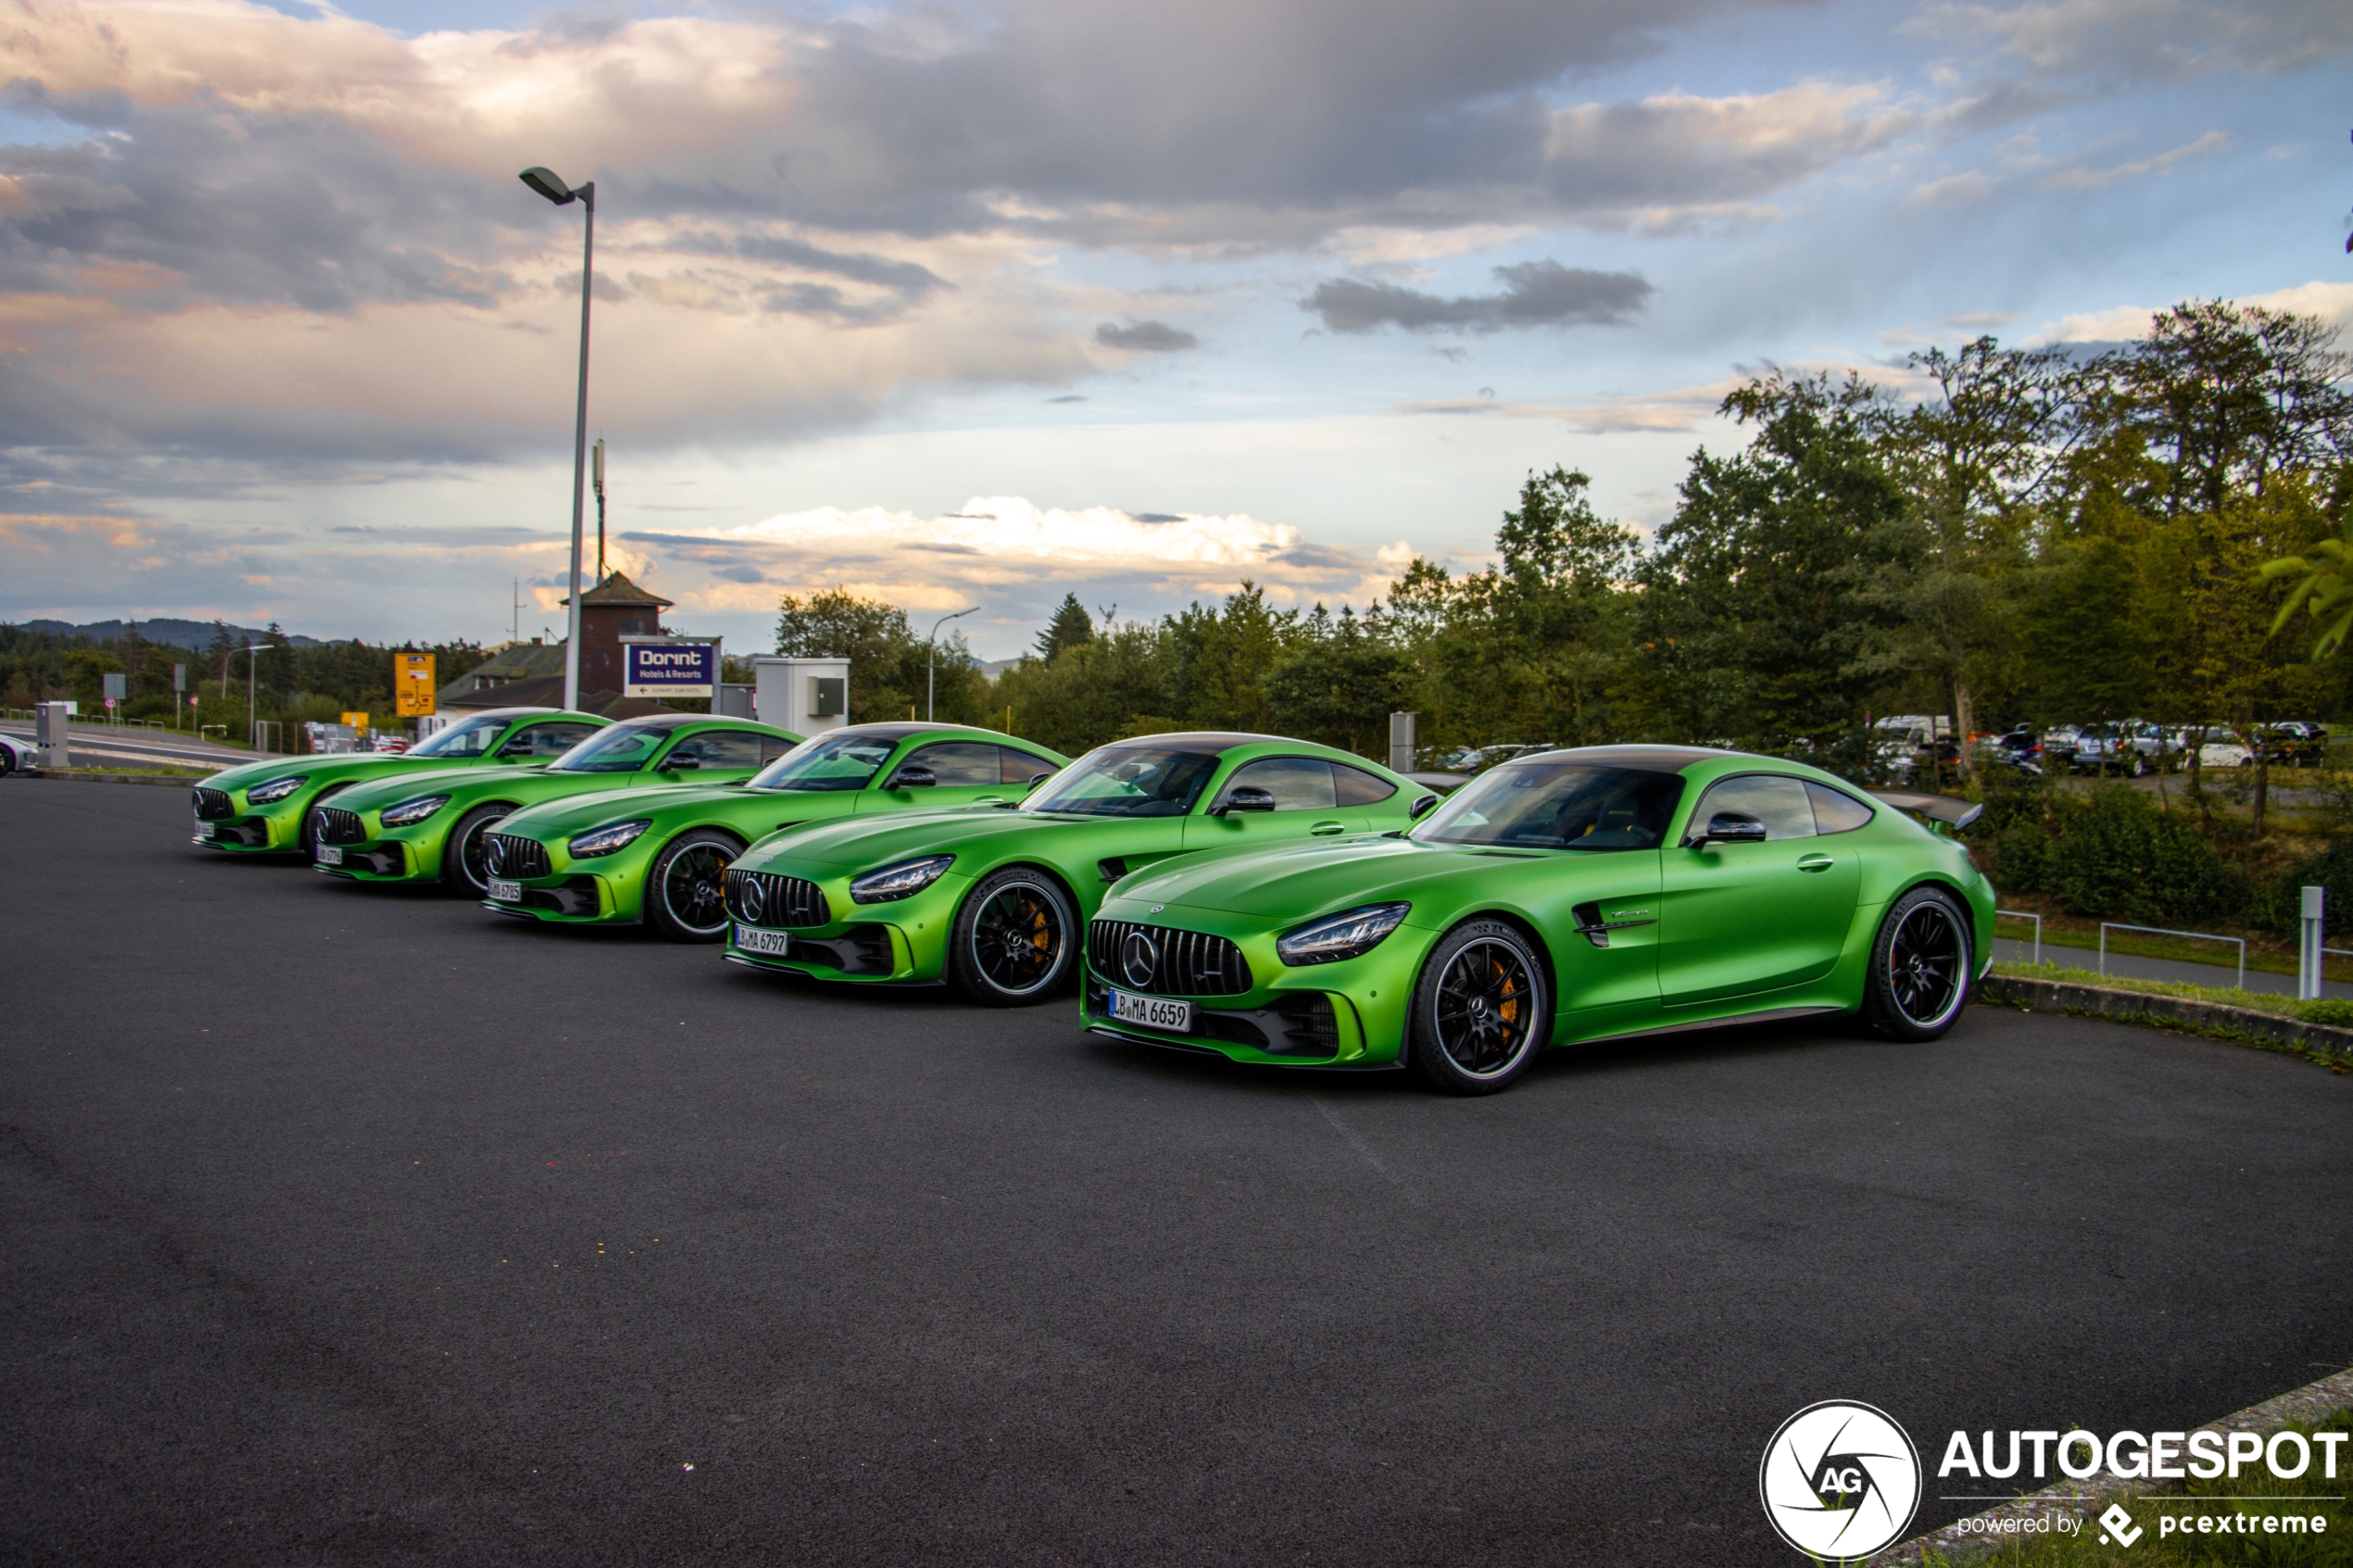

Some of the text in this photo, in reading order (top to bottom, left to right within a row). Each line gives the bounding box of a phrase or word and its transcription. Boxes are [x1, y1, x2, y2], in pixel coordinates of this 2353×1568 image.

[639, 650, 702, 666] Dorint
[639, 669, 702, 680] Hotels & Resorts
[501, 884, 520, 899] 6785
[760, 933, 785, 952] 6797
[1150, 1001, 1187, 1027] 6659
